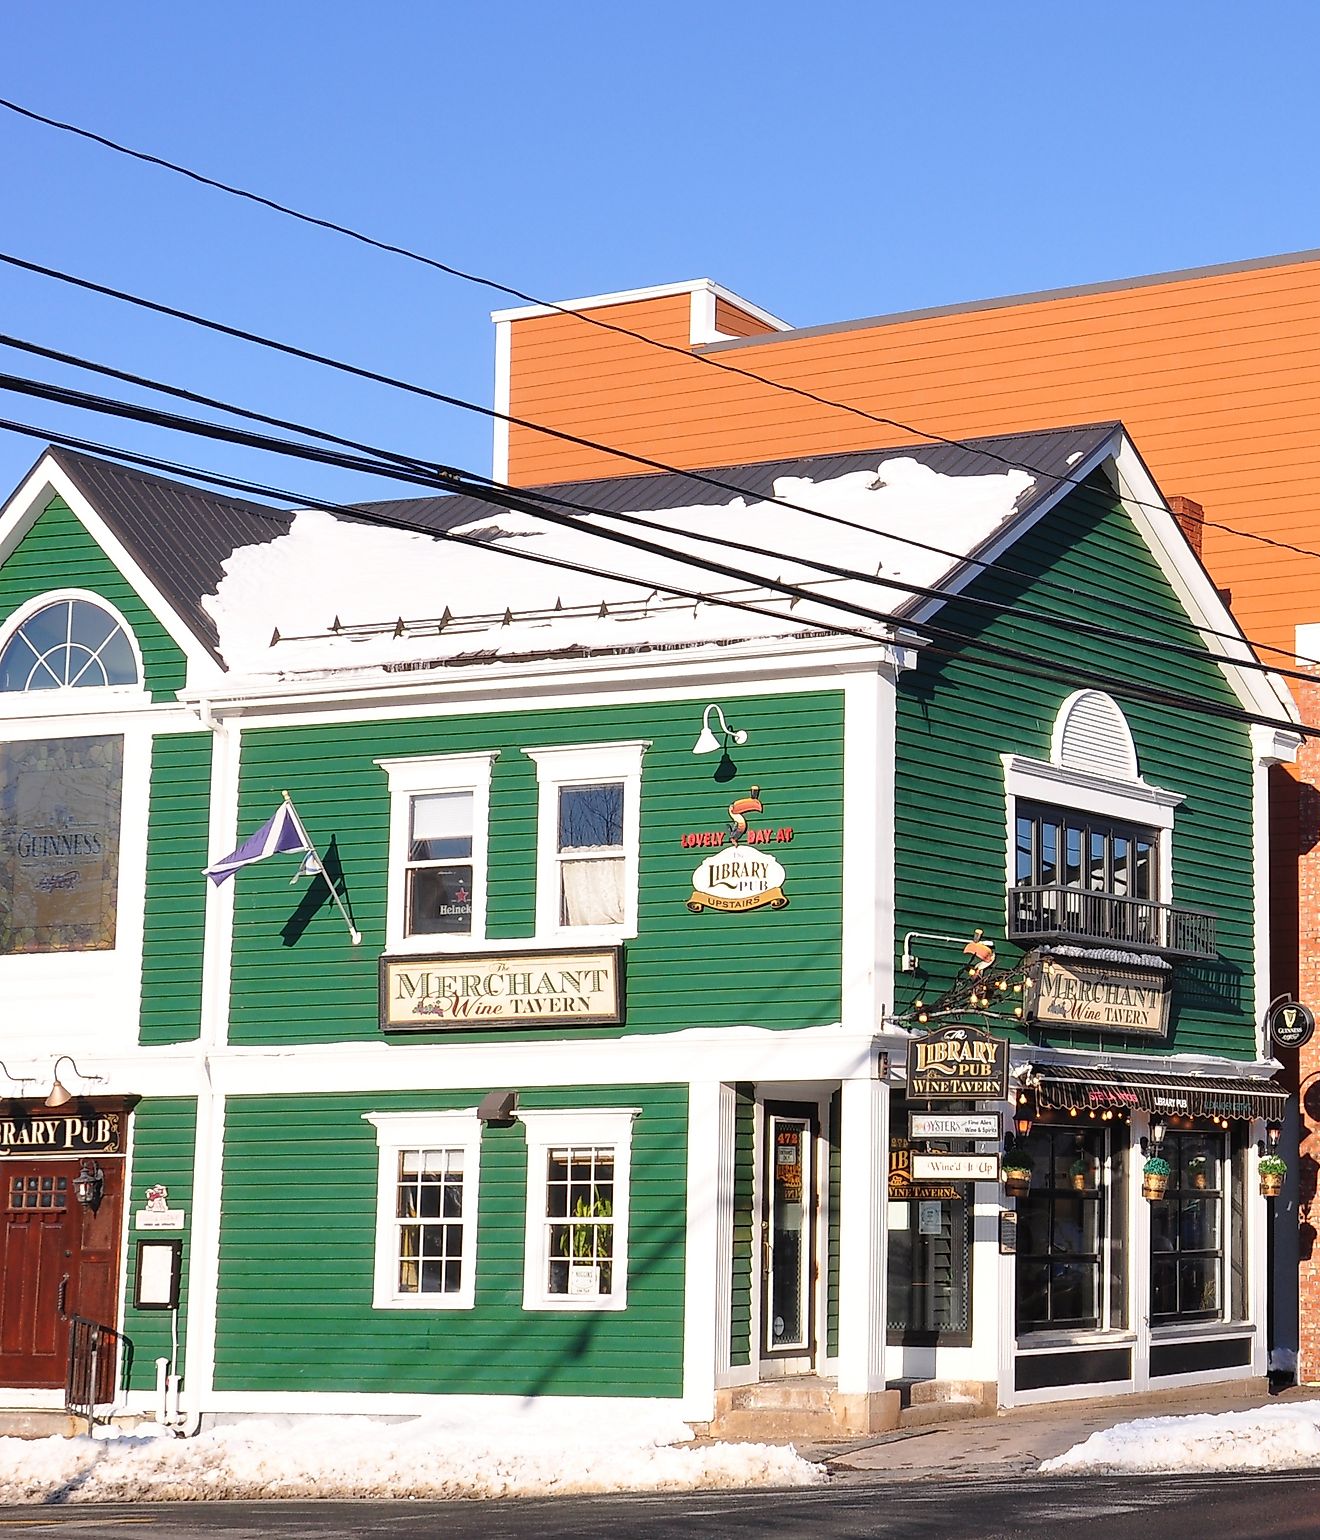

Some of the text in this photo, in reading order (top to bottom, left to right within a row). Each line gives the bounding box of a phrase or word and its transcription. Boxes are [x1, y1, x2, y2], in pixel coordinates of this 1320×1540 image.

[681, 827, 793, 848] LOVELY DAY AT
[18, 832, 102, 858] GUINNESS
[708, 861, 769, 890] LIBRARY
[739, 881, 768, 891] PUB
[707, 896, 761, 909] UPSTAIRS
[489, 963, 510, 972] The
[395, 969, 608, 999] MERCHANT
[1040, 973, 1161, 1009] MERCHANT
[422, 990, 591, 1018] Wine TAVERN
[1062, 991, 1149, 1025] Wine TAVERN
[944, 1029, 967, 1040] The
[916, 1040, 998, 1074] LIBRARY
[958, 1063, 992, 1076] PUB
[913, 1079, 1001, 1093] WINE TAVERN
[1153, 1096, 1188, 1109] LIBRARY PUB
[923, 1119, 960, 1132] OYSTERS
[0, 1117, 111, 1148] RARY PUB
[777, 1132, 798, 1145] 472
[978, 1162, 993, 1175] Up
[912, 1186, 951, 1198] TAVERN
